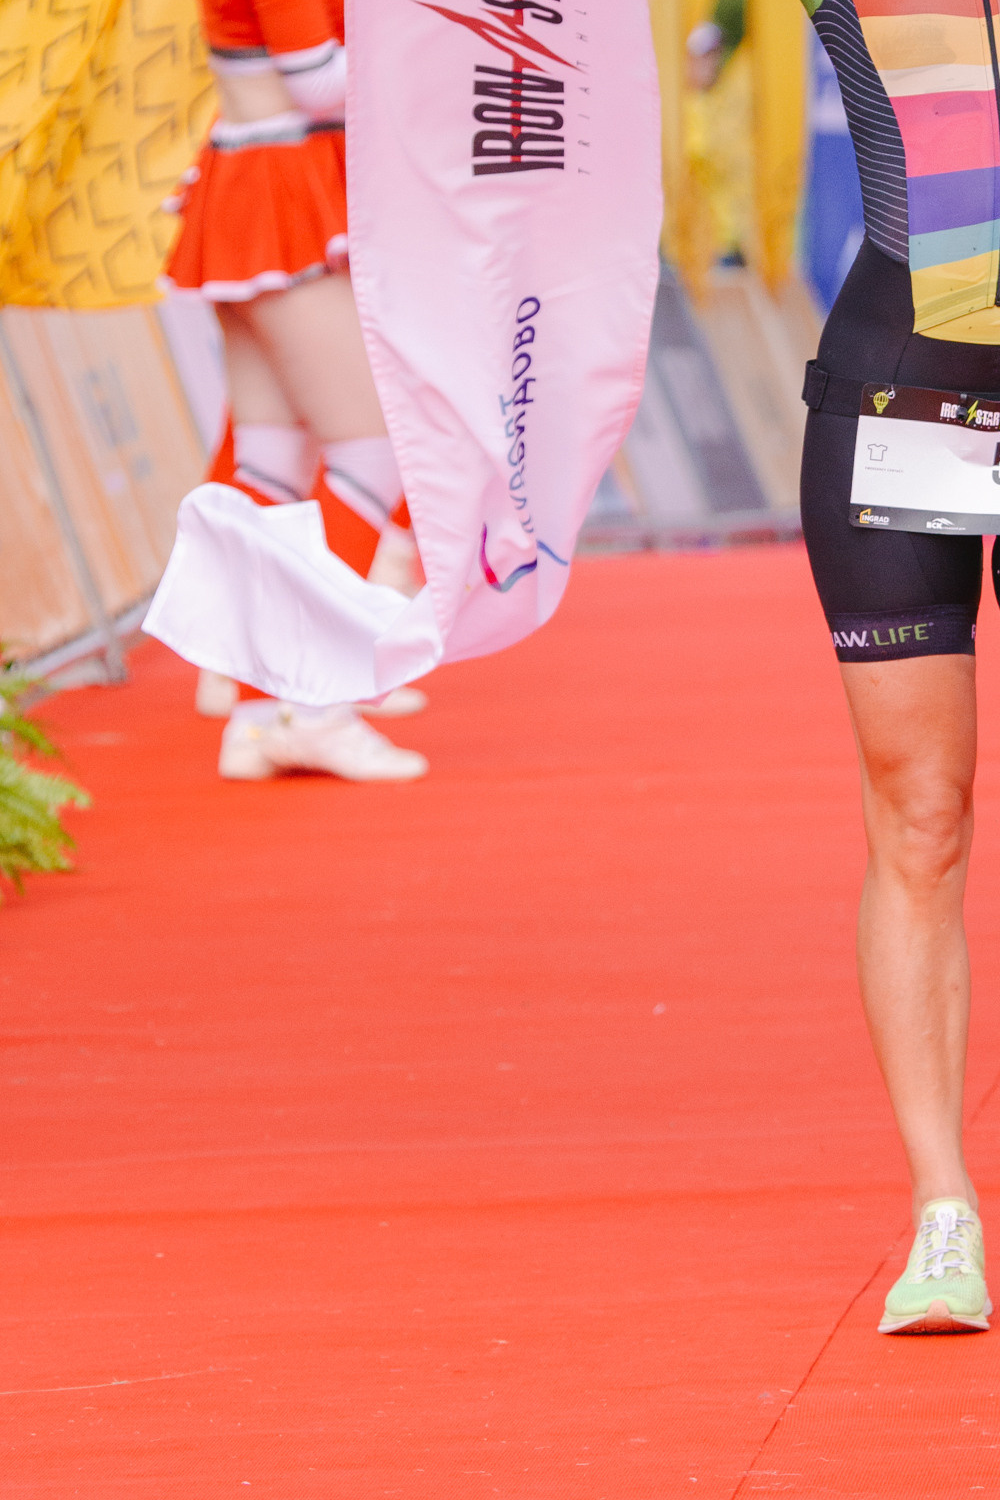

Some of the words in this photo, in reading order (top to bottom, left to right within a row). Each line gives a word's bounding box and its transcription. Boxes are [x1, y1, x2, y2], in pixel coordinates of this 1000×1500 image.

[940, 402, 964, 419] IRO
[975, 409, 1000, 427] STAR
[872, 622, 930, 647] LIFE
